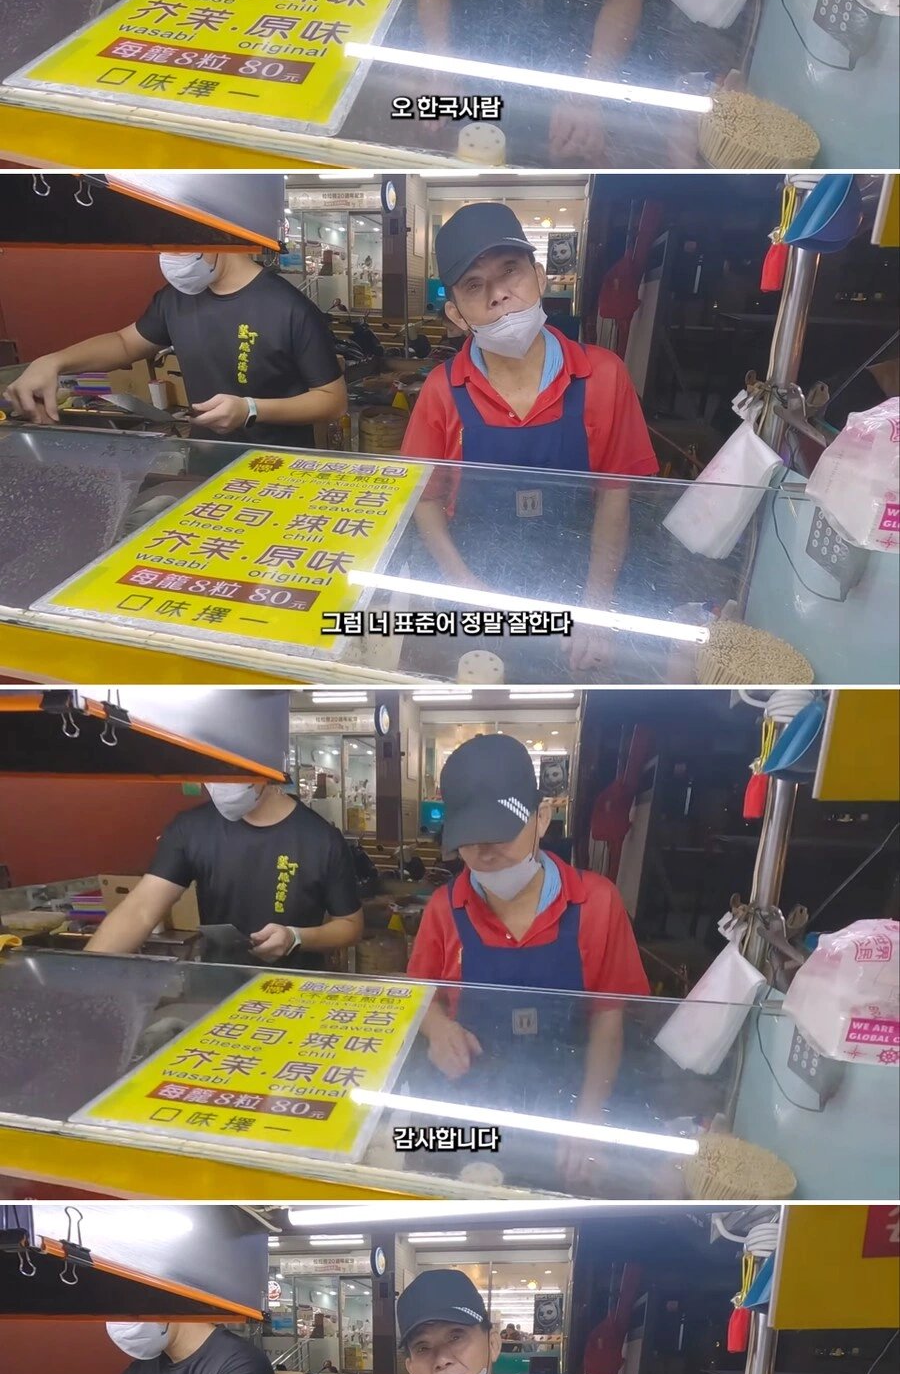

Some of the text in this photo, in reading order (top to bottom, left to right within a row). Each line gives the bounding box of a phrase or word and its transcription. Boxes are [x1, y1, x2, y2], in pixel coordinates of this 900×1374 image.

[274, 2, 319, 13] chili
[118, 24, 328, 57] wasabi original
[212, 493, 388, 515] garlic seaweed
[179, 520, 325, 543] cheese chili
[135, 552, 333, 586] wasabi original
[228, 1014, 395, 1033] garlic seaweed
[852, 1021, 894, 1033] WE ARE
[849, 1033, 890, 1042] GLOBAL
[199, 1039, 338, 1059] cheese chili
[162, 1069, 347, 1098] wasabi original
